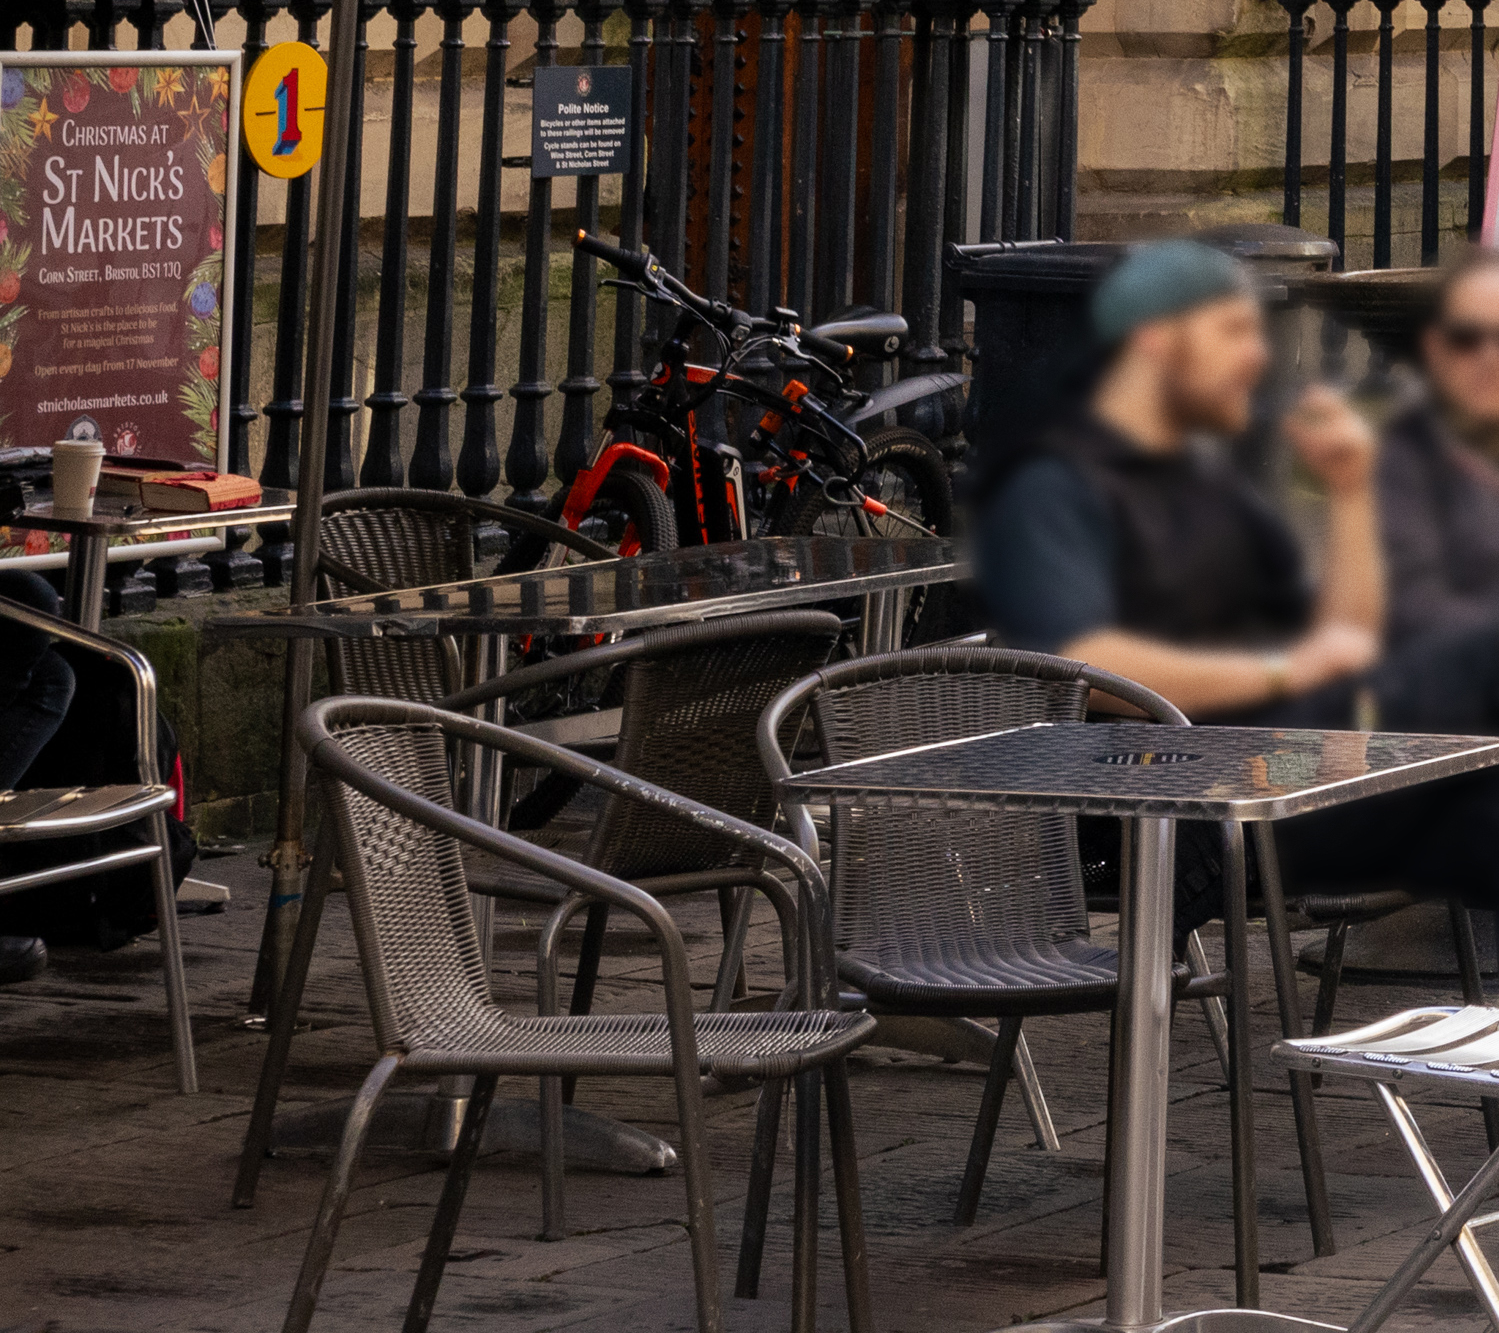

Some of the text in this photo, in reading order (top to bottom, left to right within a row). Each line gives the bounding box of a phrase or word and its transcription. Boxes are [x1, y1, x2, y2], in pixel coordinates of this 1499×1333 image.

[273, 68, 302, 154] 1
[558, 102, 610, 114] Polite Notice
[62, 119, 170, 147] CHRISTMAS AT
[43, 150, 185, 205] ST NICK'S
[42, 205, 184, 256] MARKETS
[39, 268, 65, 284] CORN
[105, 264, 140, 281] BRISTOL
[142, 263, 162, 280] BS1
[37, 390, 169, 414] stnicholasmarkets.co.uk
